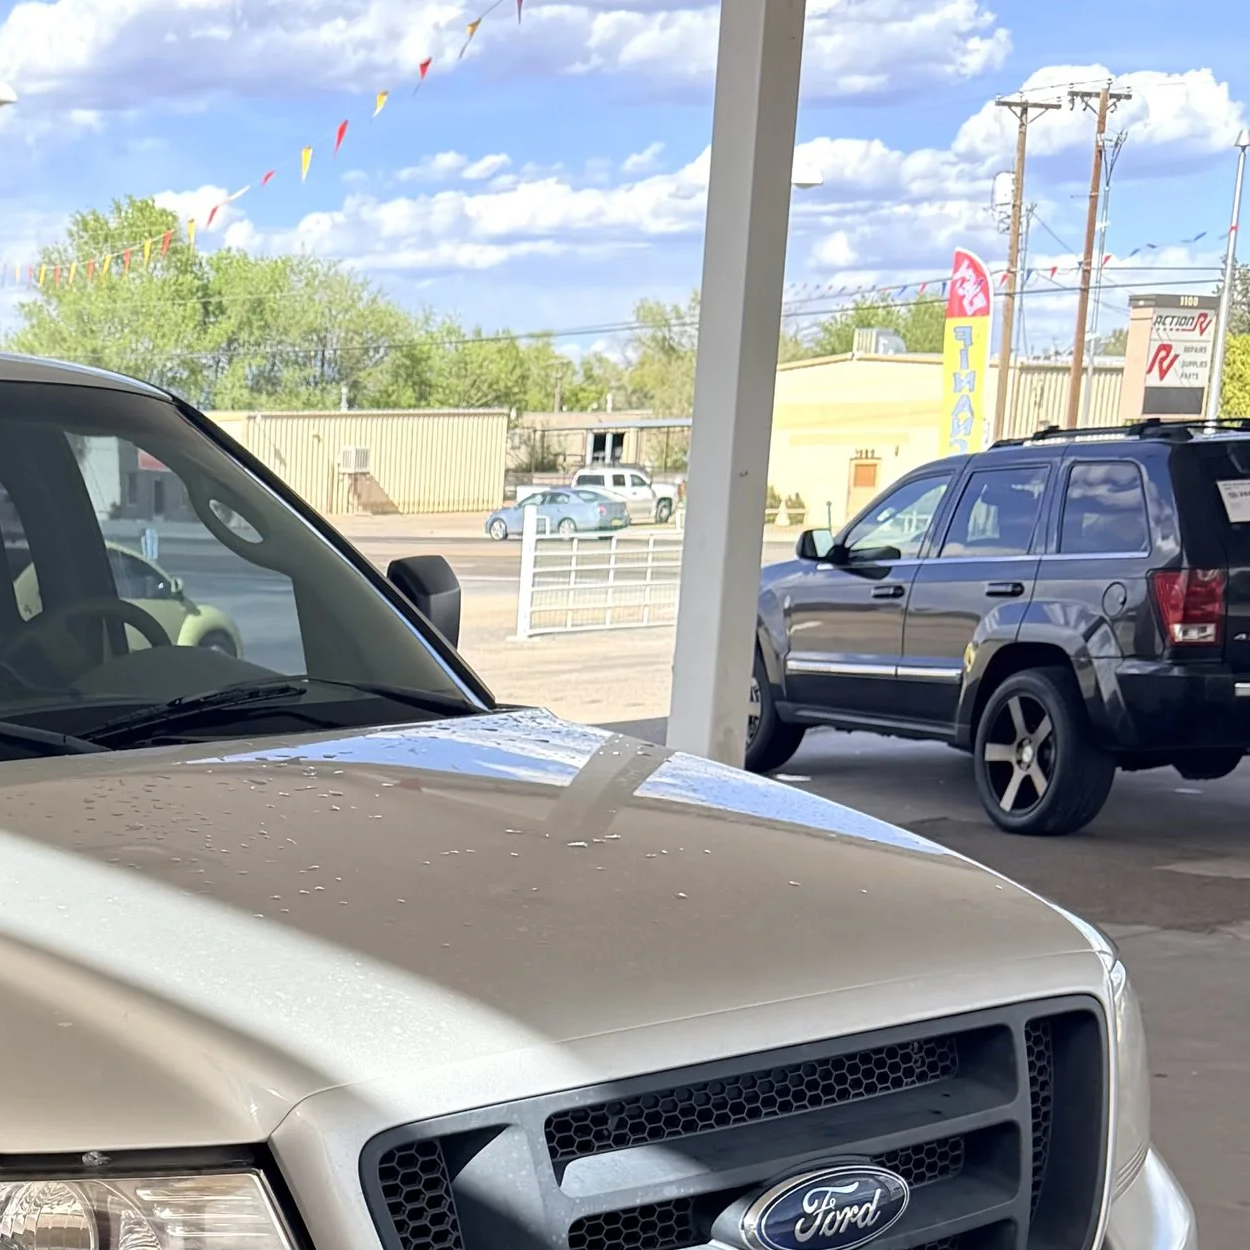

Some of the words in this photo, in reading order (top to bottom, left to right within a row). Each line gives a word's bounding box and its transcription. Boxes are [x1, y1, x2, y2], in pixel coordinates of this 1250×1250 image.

[1180, 296, 1199, 306] 1100
[1154, 315, 1196, 327] ACTION
[1146, 343, 1180, 382] RV
[793, 1181, 882, 1243] Ford
